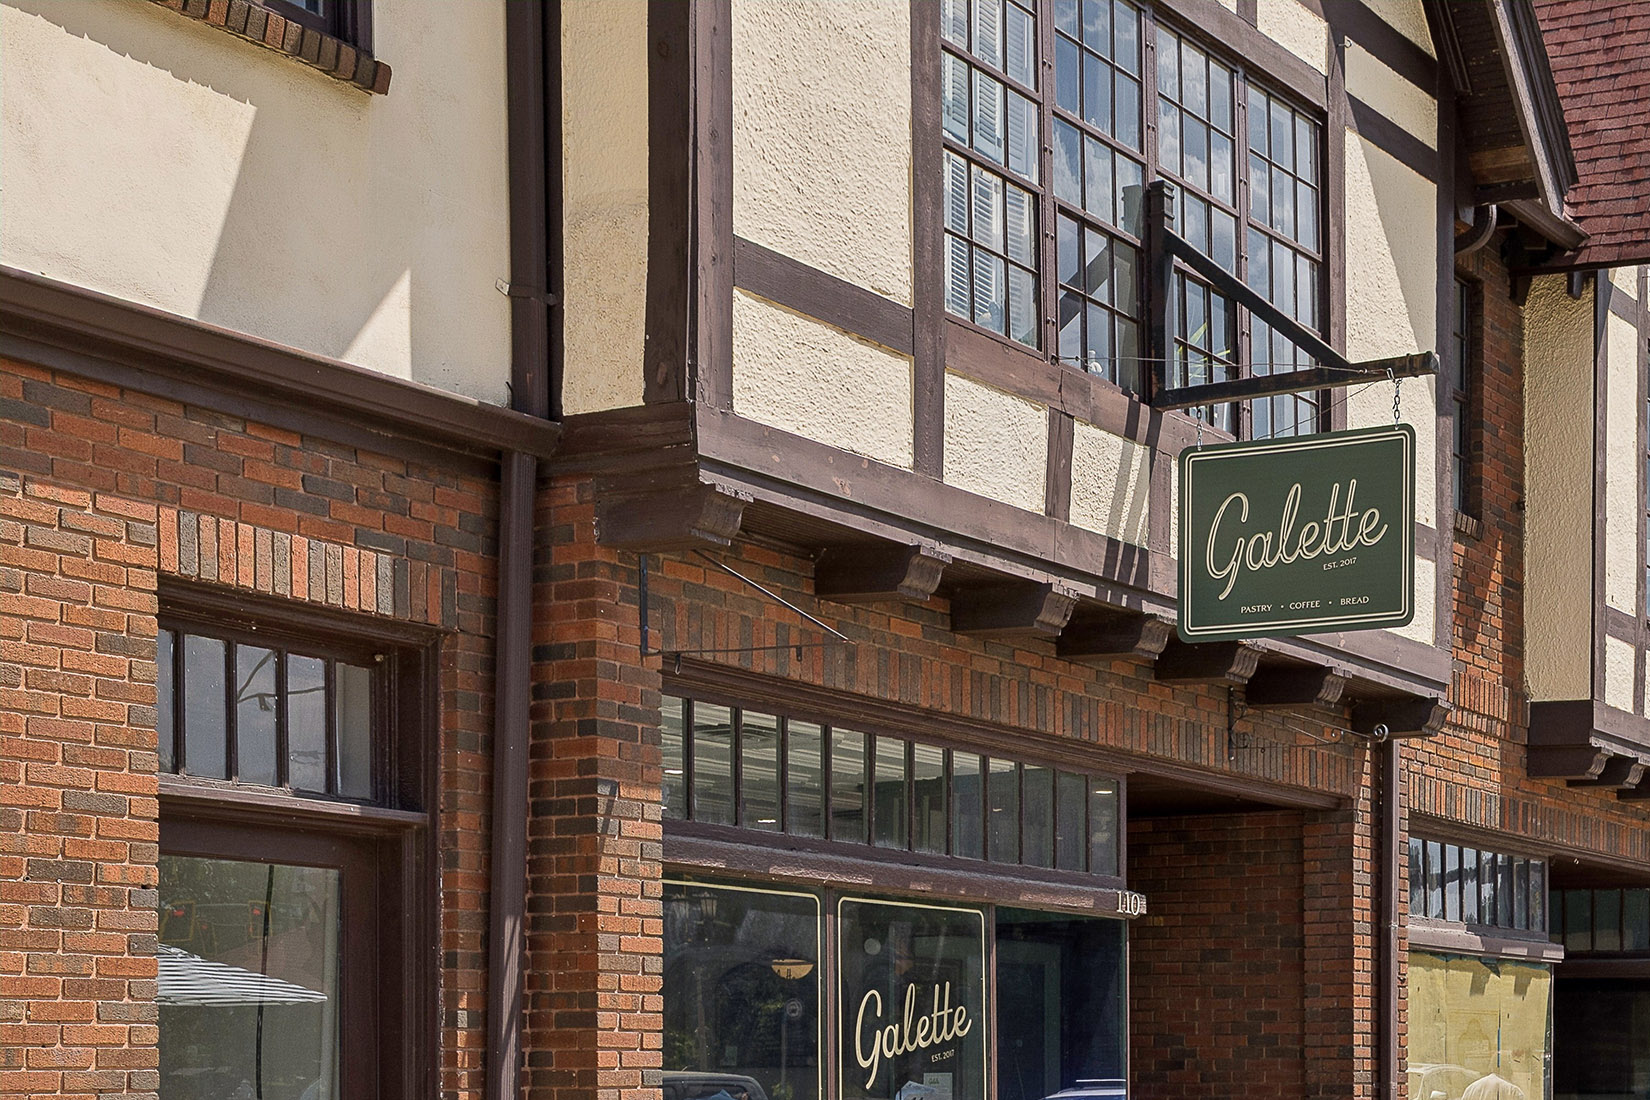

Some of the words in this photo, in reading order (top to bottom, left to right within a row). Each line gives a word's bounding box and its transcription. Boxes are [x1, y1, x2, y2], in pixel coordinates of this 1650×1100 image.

[1206, 478, 1389, 601] Galette
[1323, 560, 1338, 571] EST.
[1340, 557, 1357, 569] 2017
[1240, 603, 1273, 614] PASTRY
[1289, 600, 1321, 611] COFFEE
[1340, 596, 1370, 607] BREAD
[1116, 891, 1141, 916] 110
[854, 980, 973, 1090] Galette
[931, 1053, 942, 1063] EST.
[943, 1049, 955, 1060] 2017
